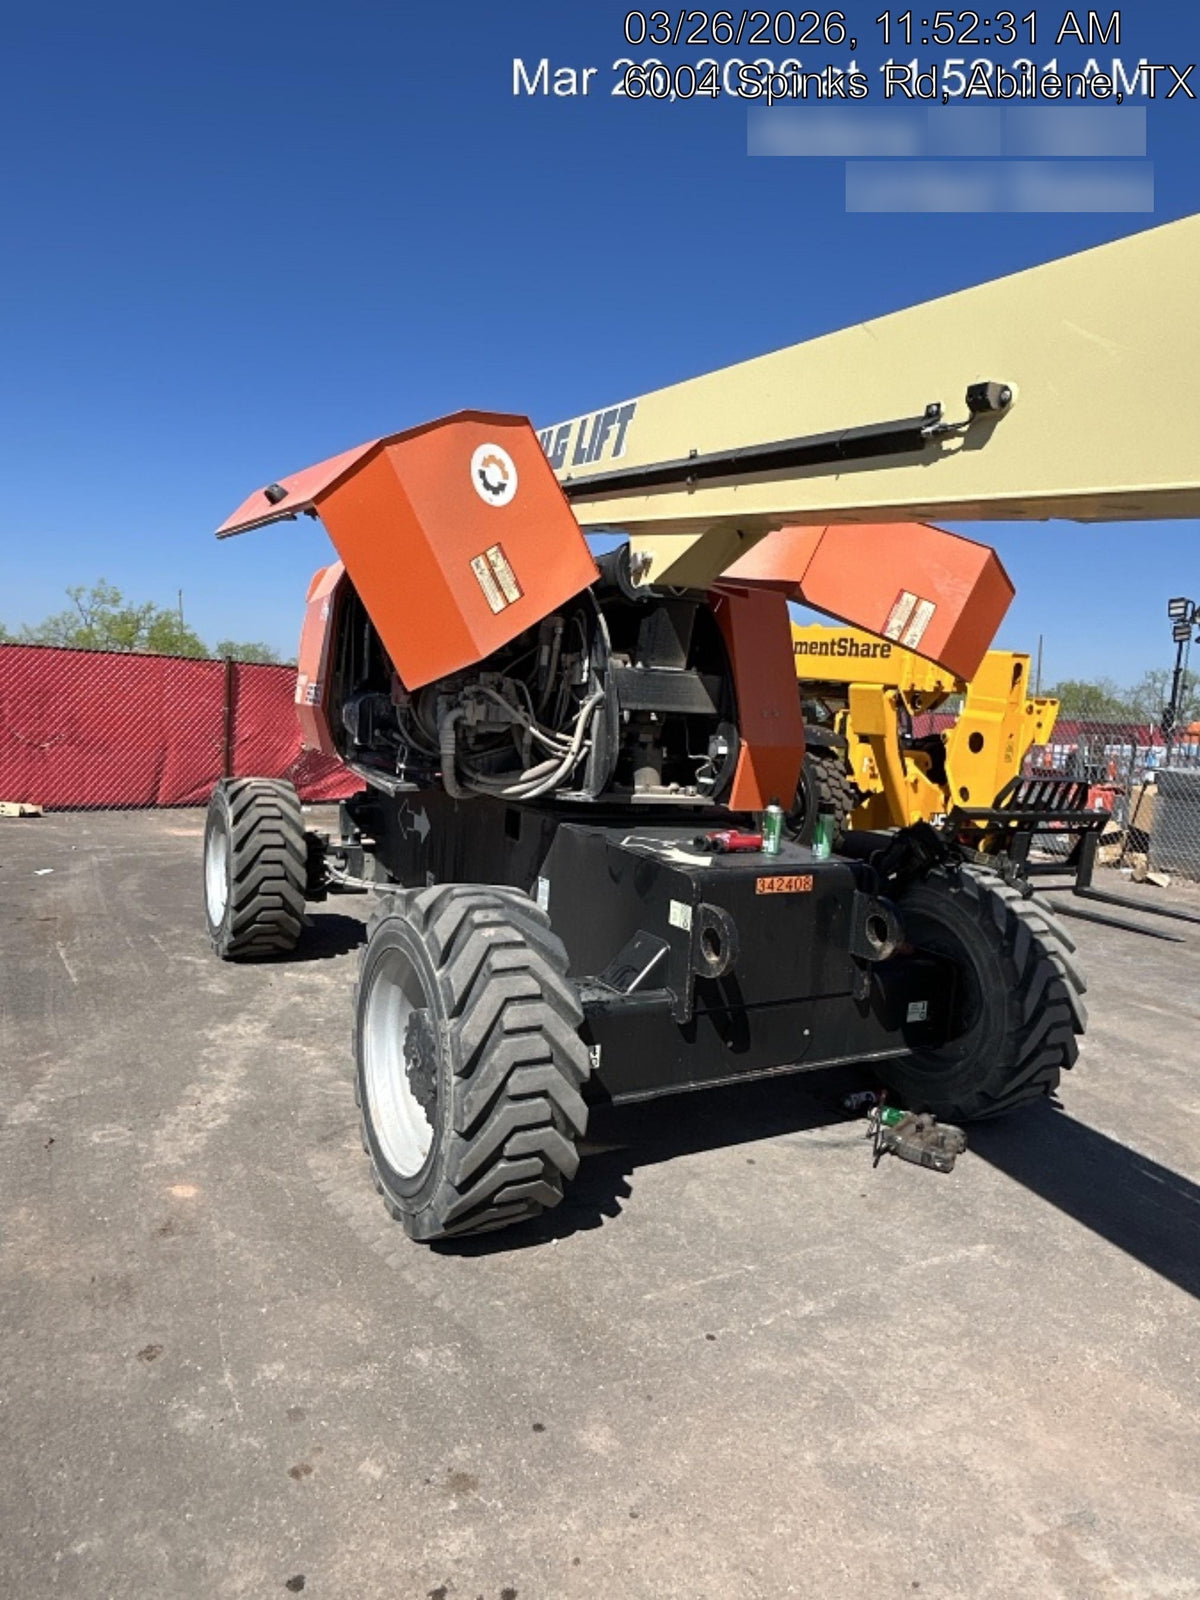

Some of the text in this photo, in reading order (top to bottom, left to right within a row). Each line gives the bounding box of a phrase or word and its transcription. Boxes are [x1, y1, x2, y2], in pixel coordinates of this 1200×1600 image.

[571, 402, 637, 466] LIFT
[794, 638, 892, 659] mentShare
[757, 875, 812, 893] 342408
